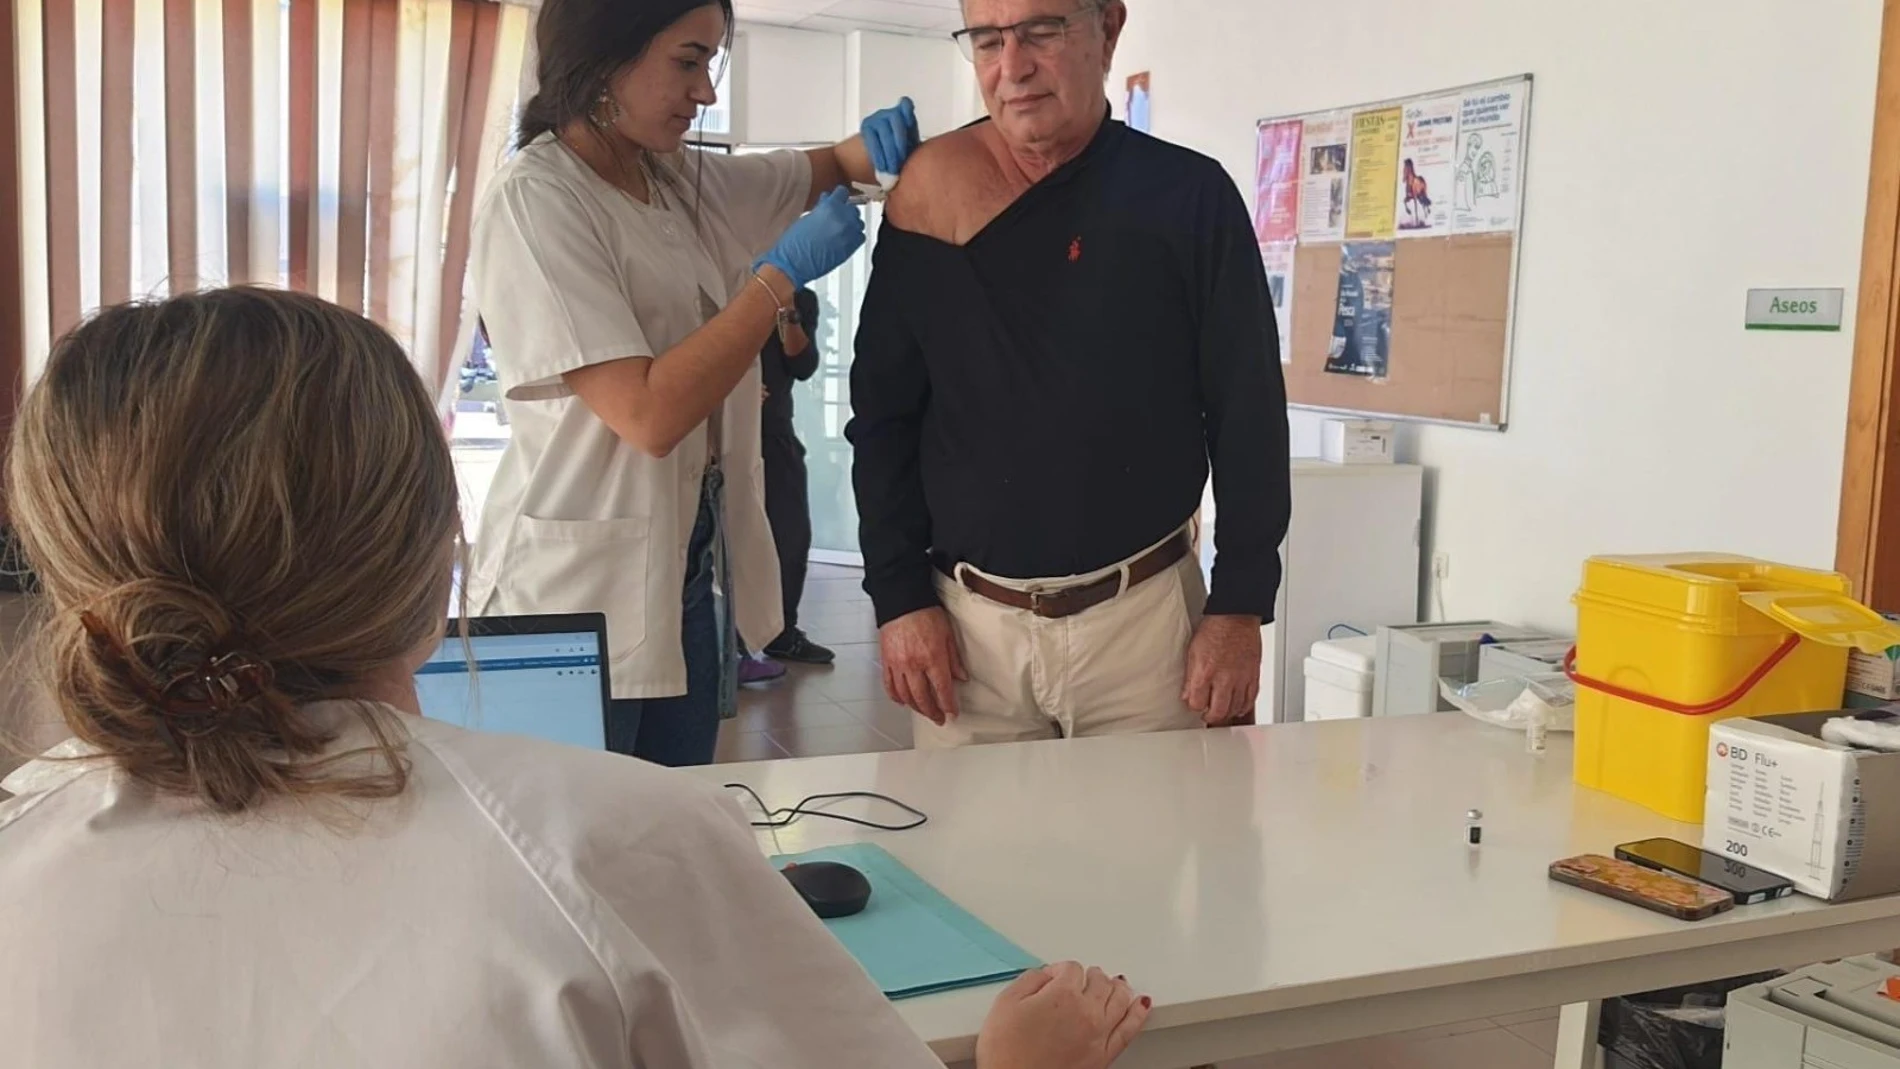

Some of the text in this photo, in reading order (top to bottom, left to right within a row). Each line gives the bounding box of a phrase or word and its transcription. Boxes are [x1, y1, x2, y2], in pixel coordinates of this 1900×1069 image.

[1487, 93, 1511, 104] cambio
[1462, 108, 1474, 118] que
[1476, 105, 1498, 115] quieres
[1478, 113, 1500, 123] mundo
[1356, 115, 1385, 130] FIESTAS
[1769, 296, 1818, 314] Aseos
[1730, 746, 1778, 767] BD Flu+
[1725, 840, 1748, 857] 200
